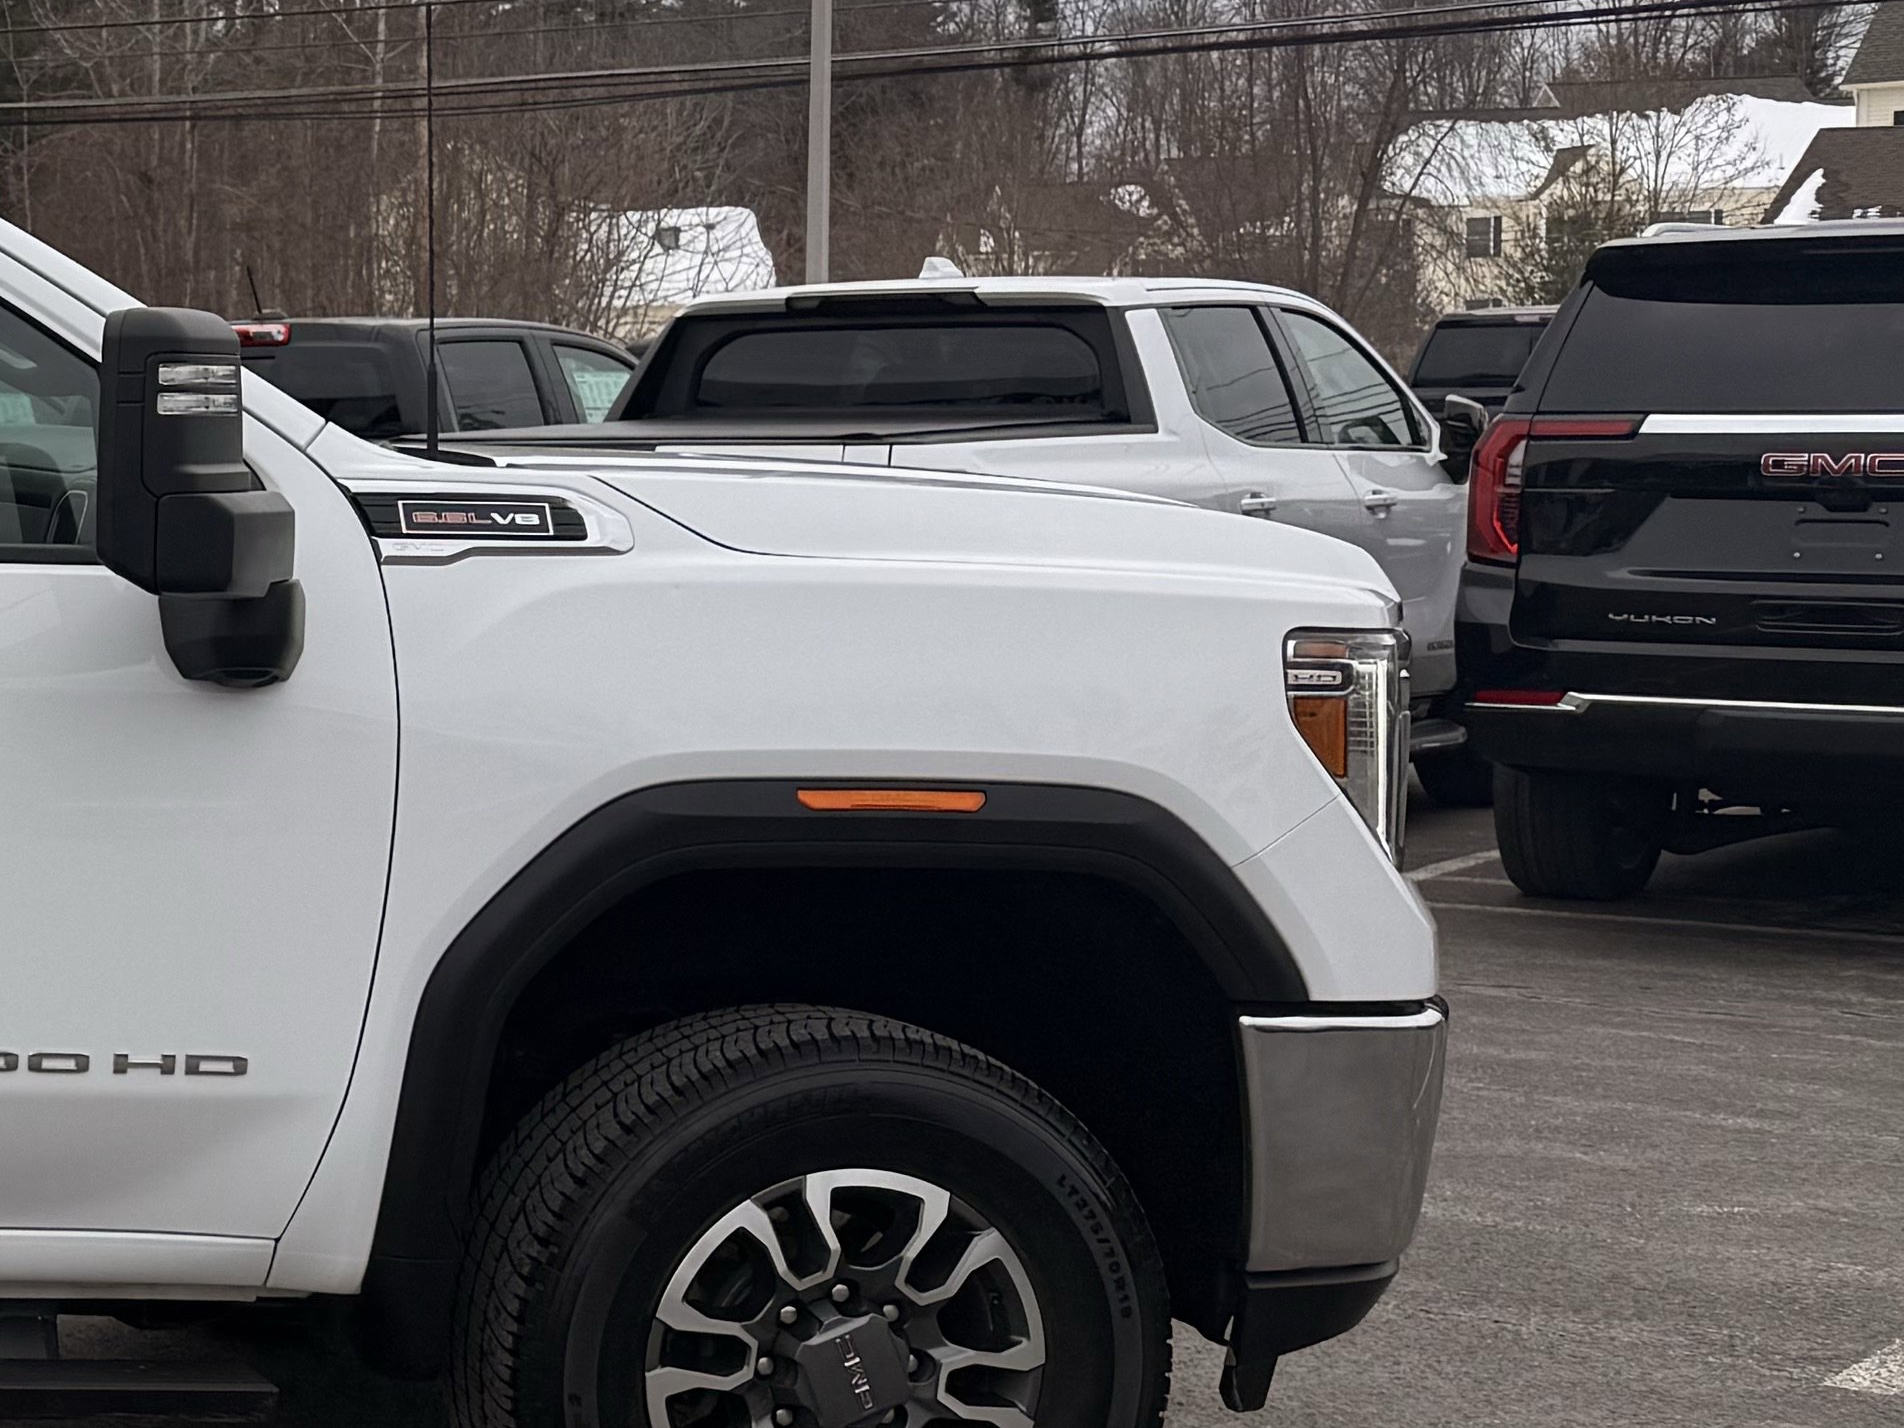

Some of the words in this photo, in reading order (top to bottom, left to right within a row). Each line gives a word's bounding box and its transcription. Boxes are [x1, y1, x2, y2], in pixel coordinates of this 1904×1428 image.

[1760, 452, 1904, 477] GMC
[1608, 613, 1717, 625] YUKON
[835, 1333, 874, 1411] GMC
